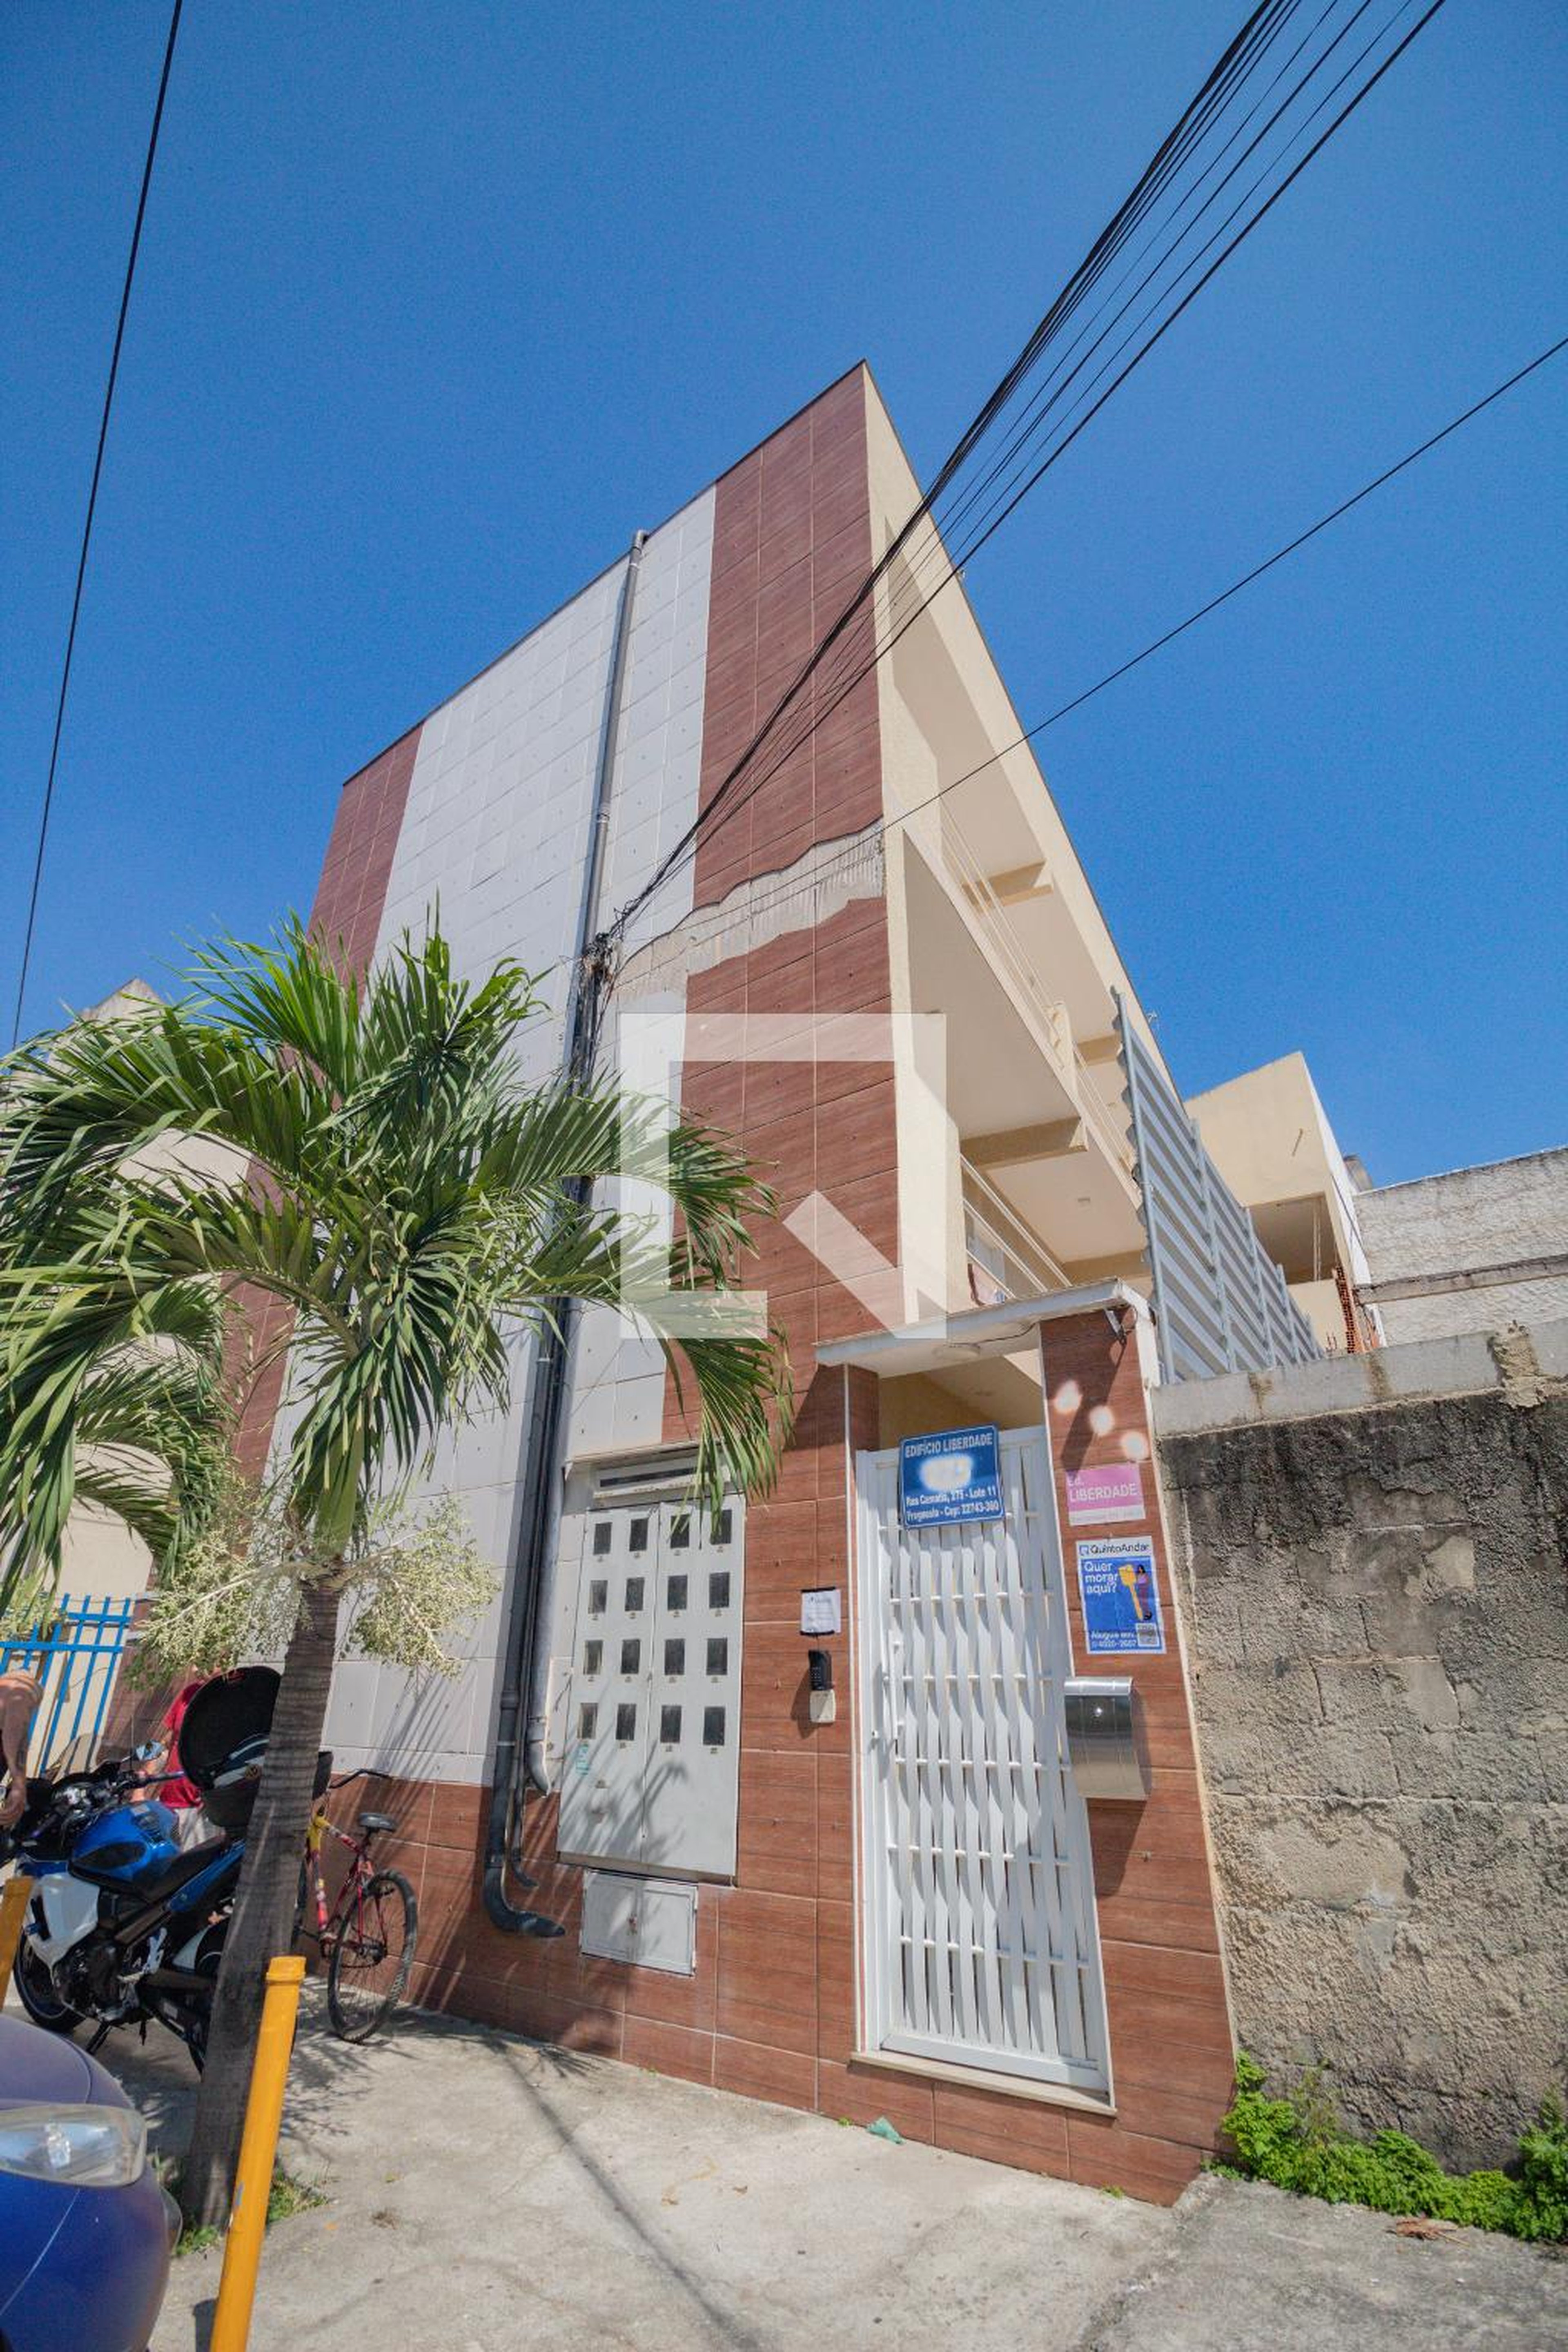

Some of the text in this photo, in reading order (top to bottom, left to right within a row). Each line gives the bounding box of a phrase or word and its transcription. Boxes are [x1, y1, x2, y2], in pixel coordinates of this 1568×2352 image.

[905, 1433, 993, 1458] EDIFÍCIO LIBERDADE
[969, 1487, 985, 1498] Lote
[1070, 1483, 1138, 1503] LIBERDADE
[1090, 1543, 1149, 1554] QuintoAndar
[1084, 1561, 1113, 1572] Quer
[1085, 1573, 1118, 1584] morar
[1087, 1581, 1117, 1596] aqui?
